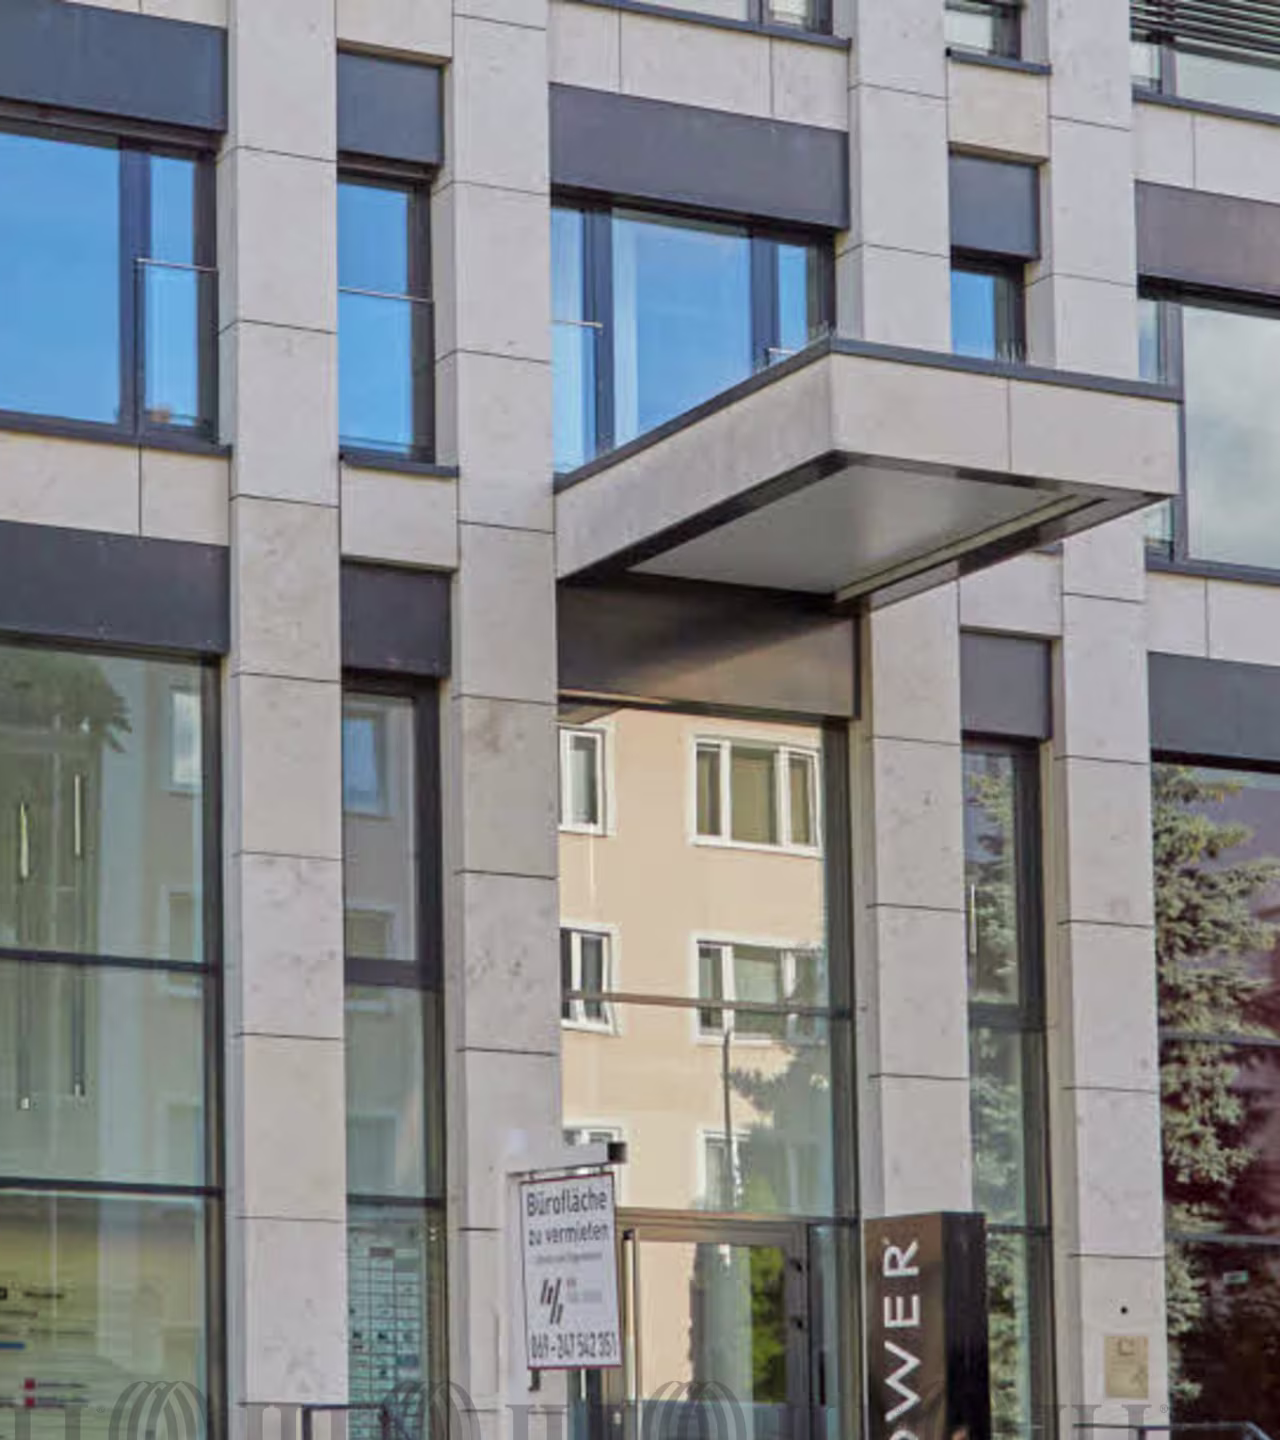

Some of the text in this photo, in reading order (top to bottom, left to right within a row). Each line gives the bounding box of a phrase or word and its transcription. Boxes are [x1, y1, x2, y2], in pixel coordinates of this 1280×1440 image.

[527, 1186, 607, 1217] Bürofläche
[529, 1222, 608, 1246] zu vermieten
